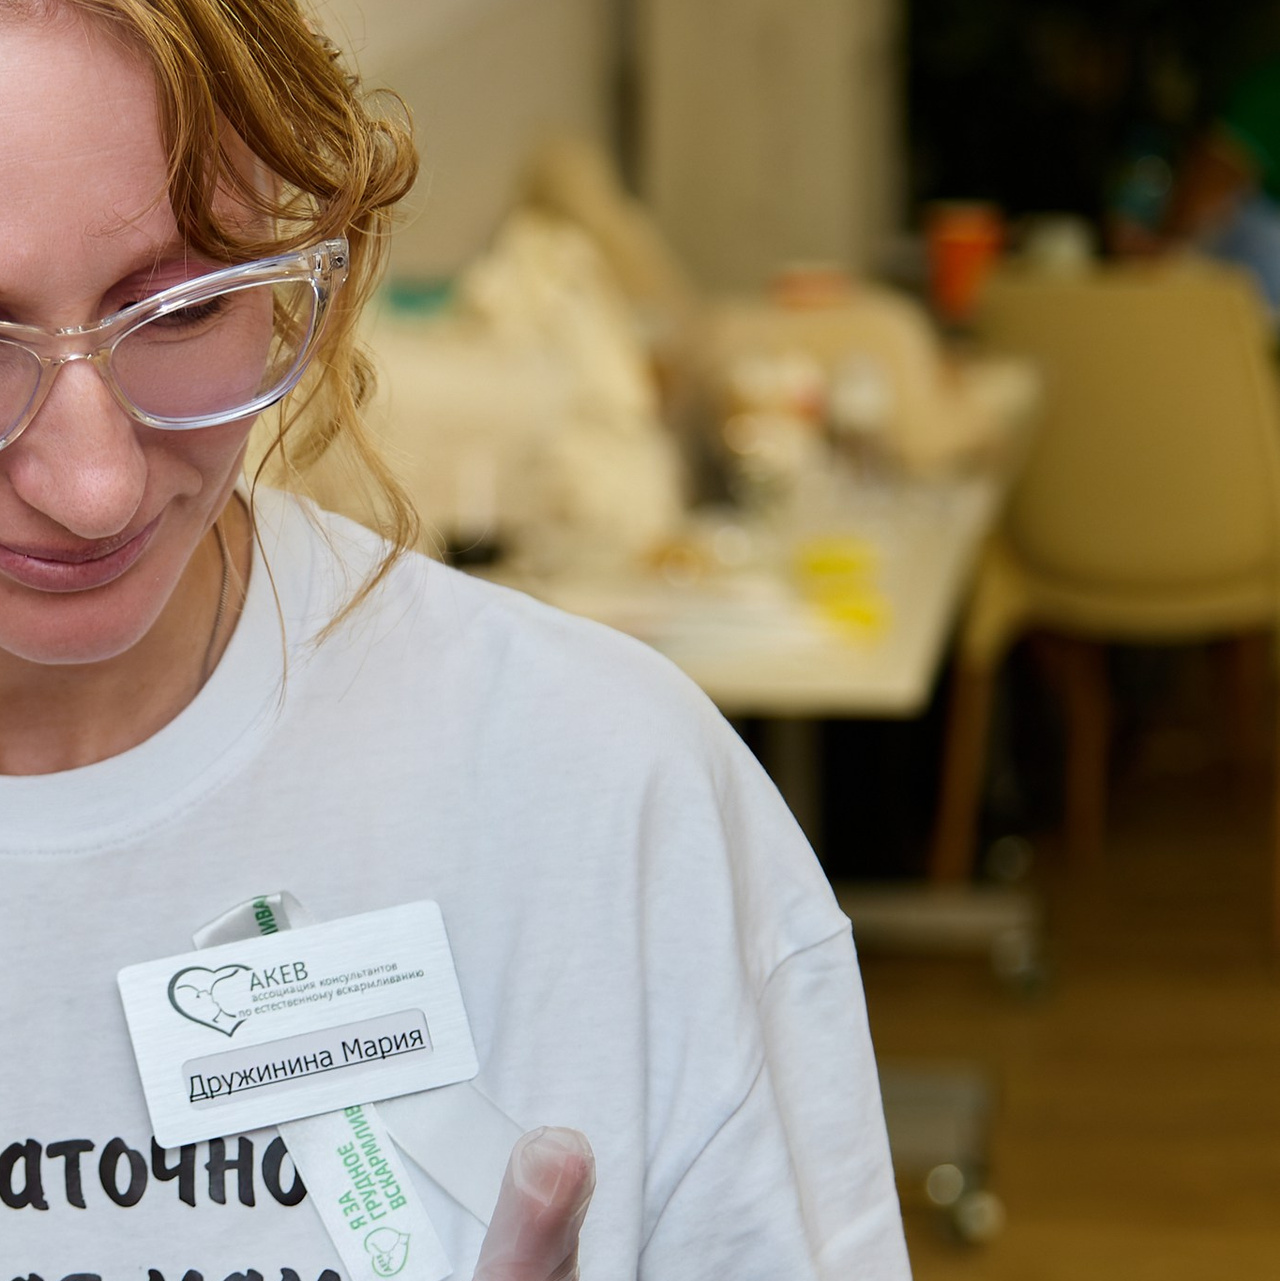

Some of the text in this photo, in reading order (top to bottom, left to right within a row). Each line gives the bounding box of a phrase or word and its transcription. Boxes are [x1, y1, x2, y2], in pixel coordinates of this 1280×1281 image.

[238, 969, 425, 1019] по естественному вскармливанию
[249, 961, 309, 992] АКЕВ
[252, 963, 398, 1003] ассоциация консультантов
[189, 1029, 426, 1102] Дружинина Мария
[337, 1141, 388, 1221] ГРУДНОЕ
[344, 1104, 407, 1210] ВСКАРМЛИВ
[338, 1189, 368, 1230] Я ЗА
